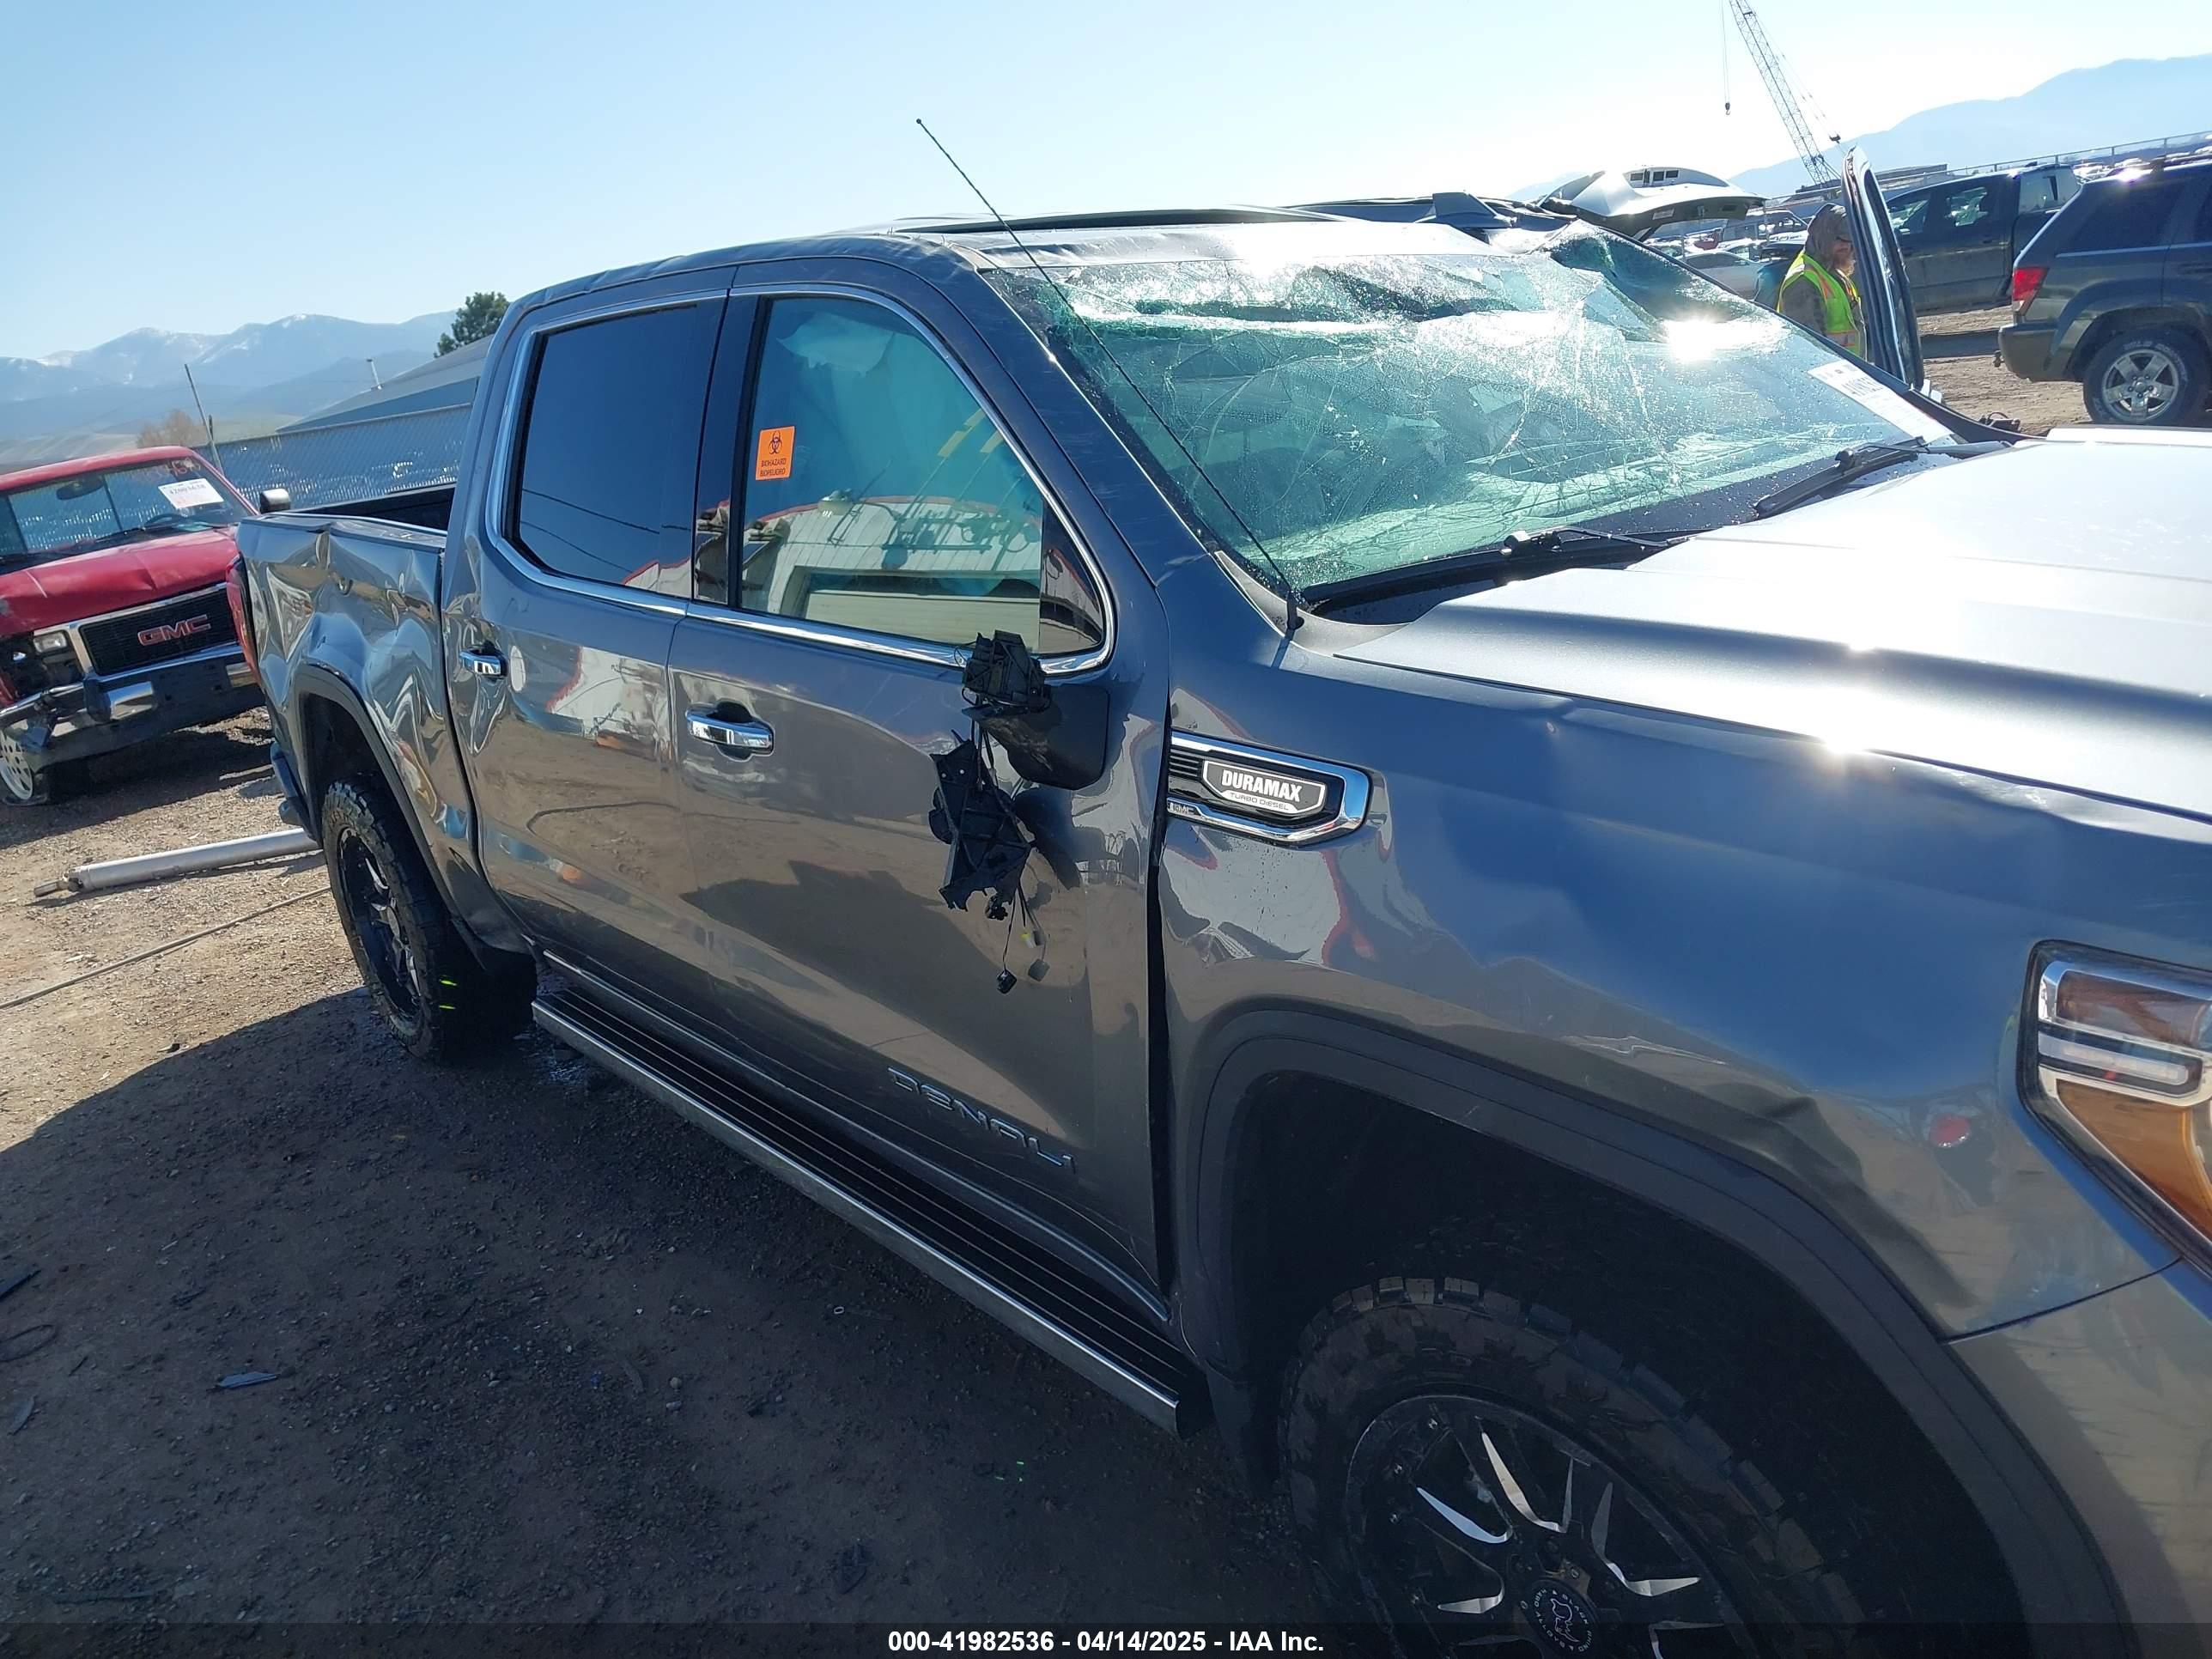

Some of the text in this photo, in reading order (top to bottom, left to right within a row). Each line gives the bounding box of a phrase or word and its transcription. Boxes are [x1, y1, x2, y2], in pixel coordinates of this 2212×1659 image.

[761, 458, 787, 467] BIOHAZARD
[137, 614, 212, 646] GMC
[1221, 769, 1303, 802] DURAMAX
[1230, 792, 1290, 811] TURBO DIESEL
[887, 1066, 1077, 1175] DENALI
[1534, 1589, 1547, 1607] HARD
[1562, 1594, 1589, 1625] BLACK
